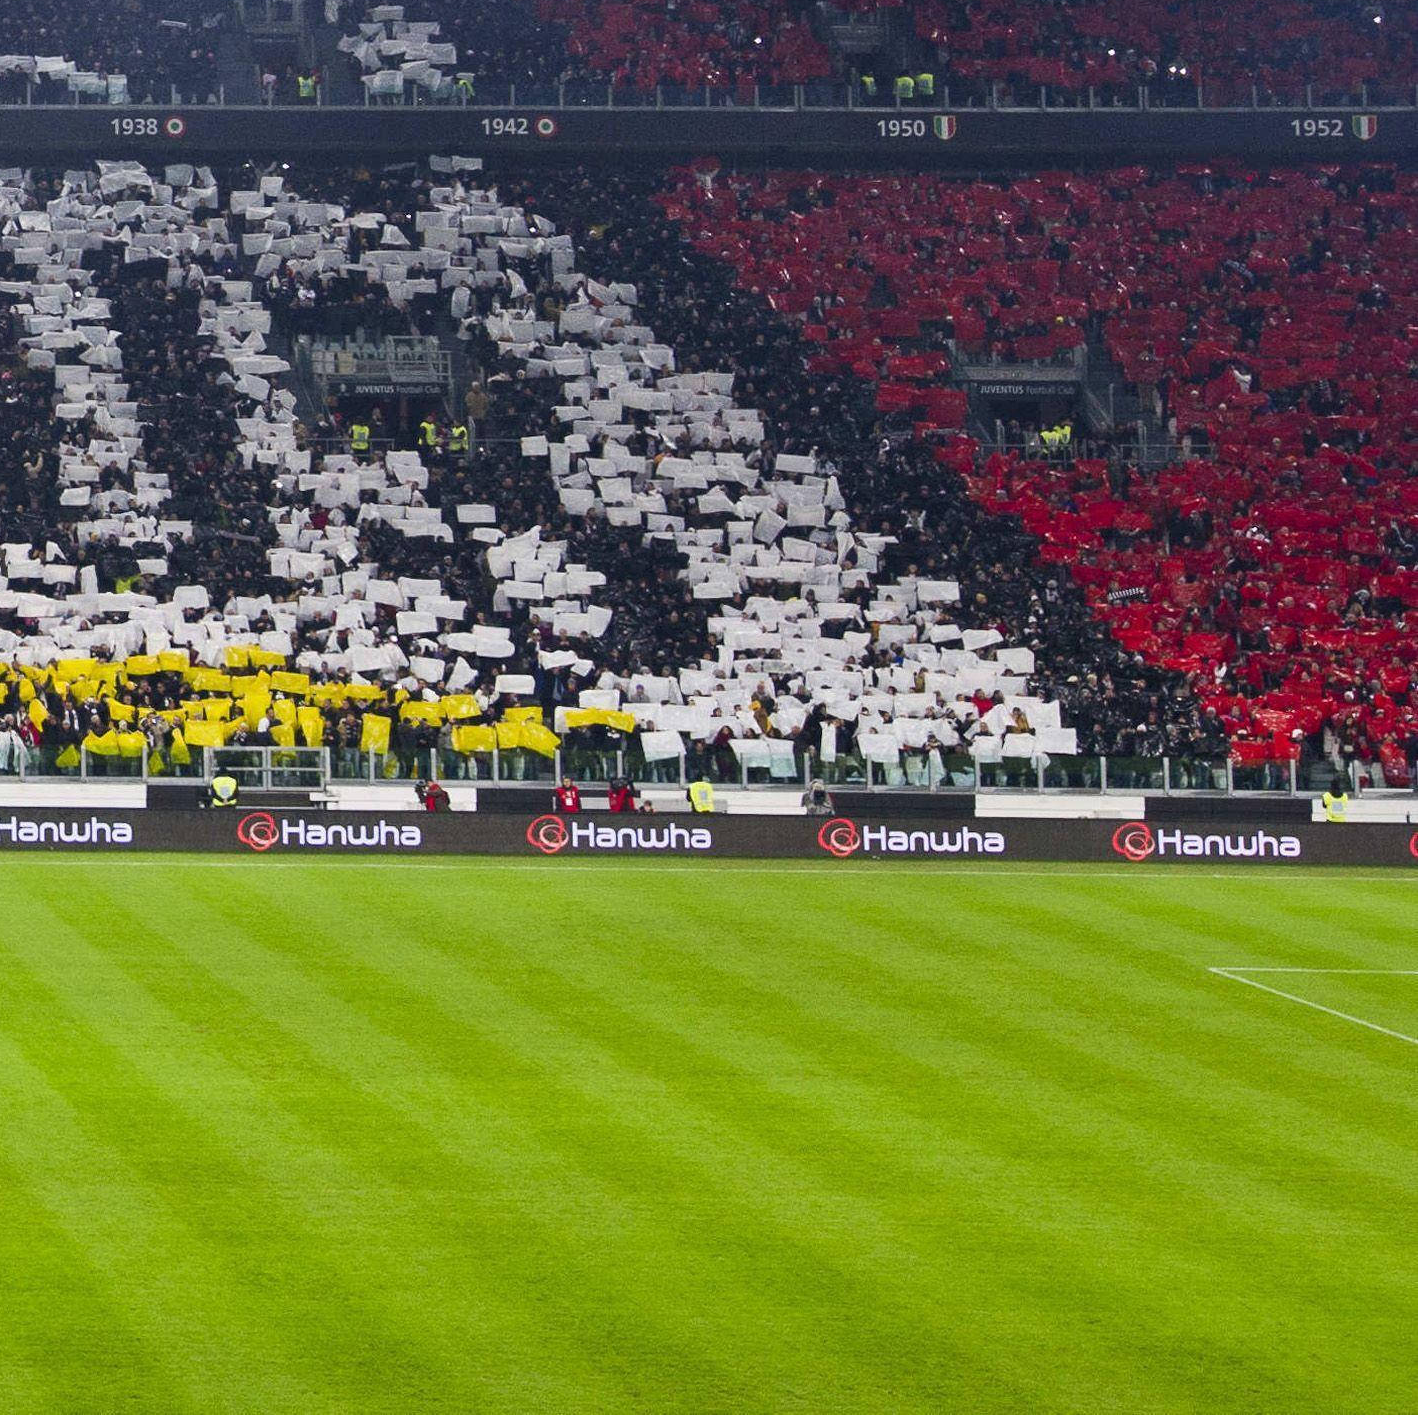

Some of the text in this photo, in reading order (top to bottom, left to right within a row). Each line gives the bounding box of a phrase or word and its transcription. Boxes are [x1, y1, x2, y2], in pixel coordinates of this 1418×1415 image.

[111, 118, 158, 135] 1938
[481, 118, 528, 135] 1942
[876, 119, 926, 137] 1950
[1291, 119, 1344, 137] 1952
[355, 385, 395, 394] JUVENTUS
[980, 385, 1024, 394] JUVENTUS
[282, 820, 420, 845] Hanwha
[572, 822, 711, 848] Hanwha
[862, 826, 1004, 852] Hanwha
[1157, 830, 1300, 856] Hanwha
